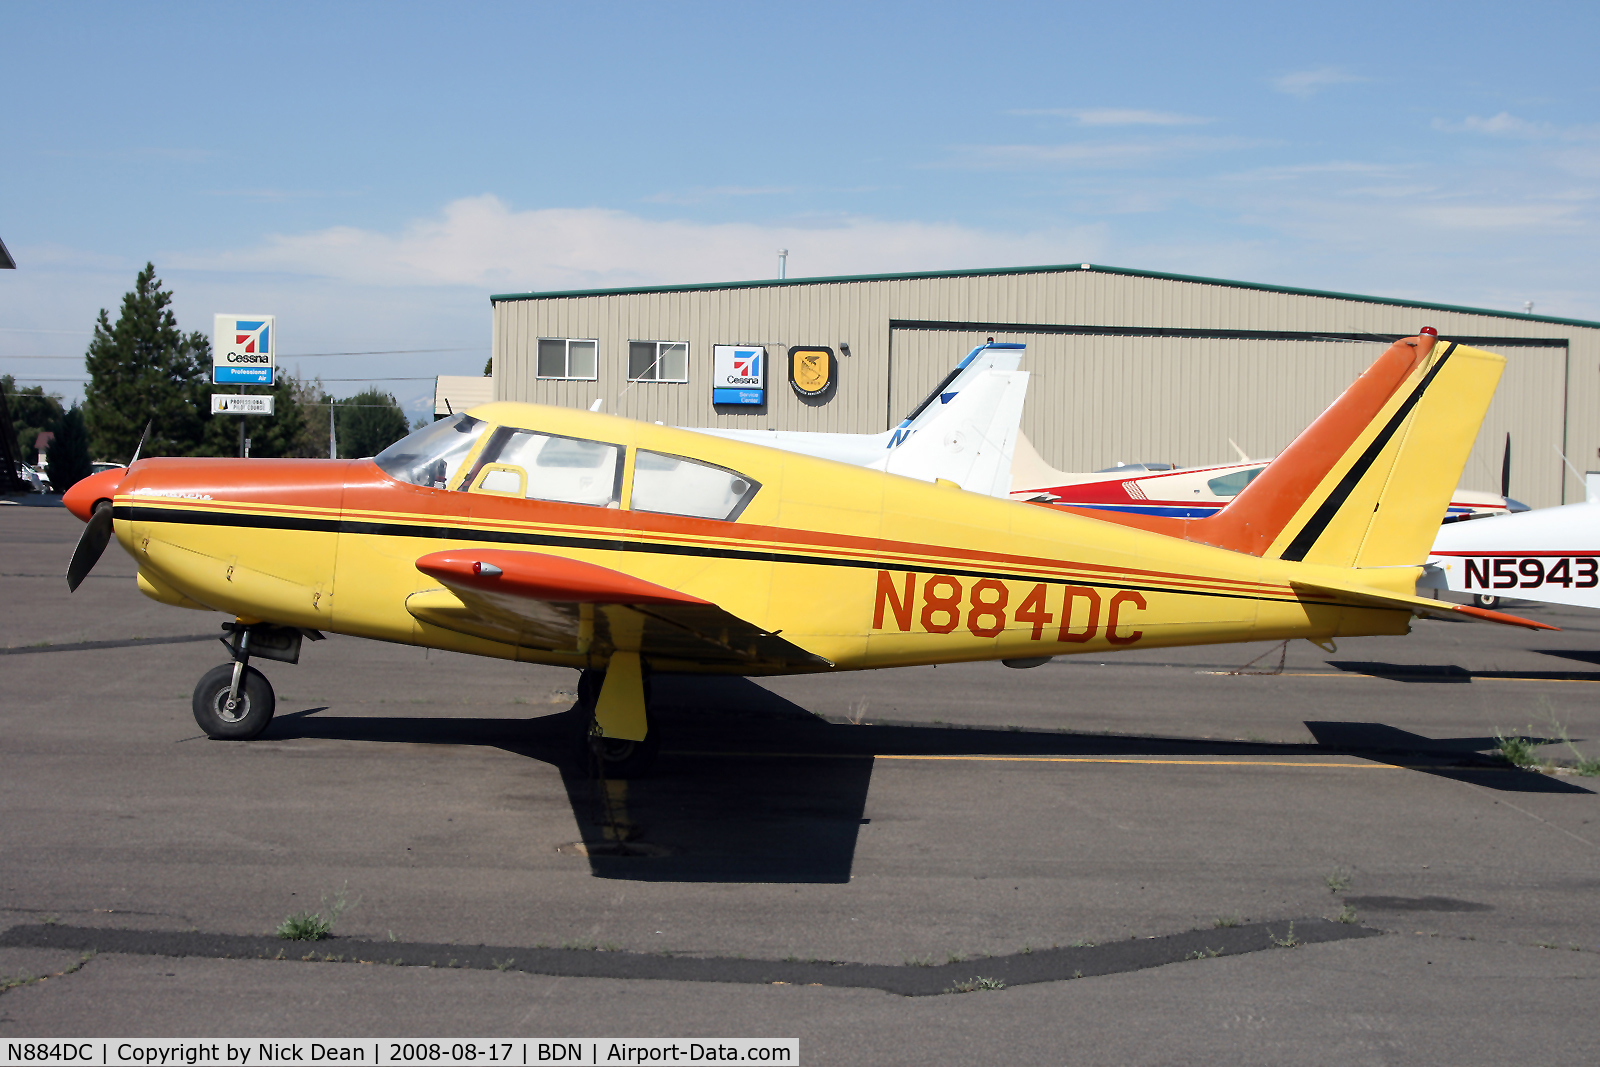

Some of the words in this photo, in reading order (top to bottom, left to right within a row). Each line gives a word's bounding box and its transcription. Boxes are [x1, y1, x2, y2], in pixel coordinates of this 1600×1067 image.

[226, 352, 269, 363] Cessna
[726, 375, 759, 384] Cessna
[1464, 558, 1599, 589] N5943
[872, 570, 1147, 646] N884DC
